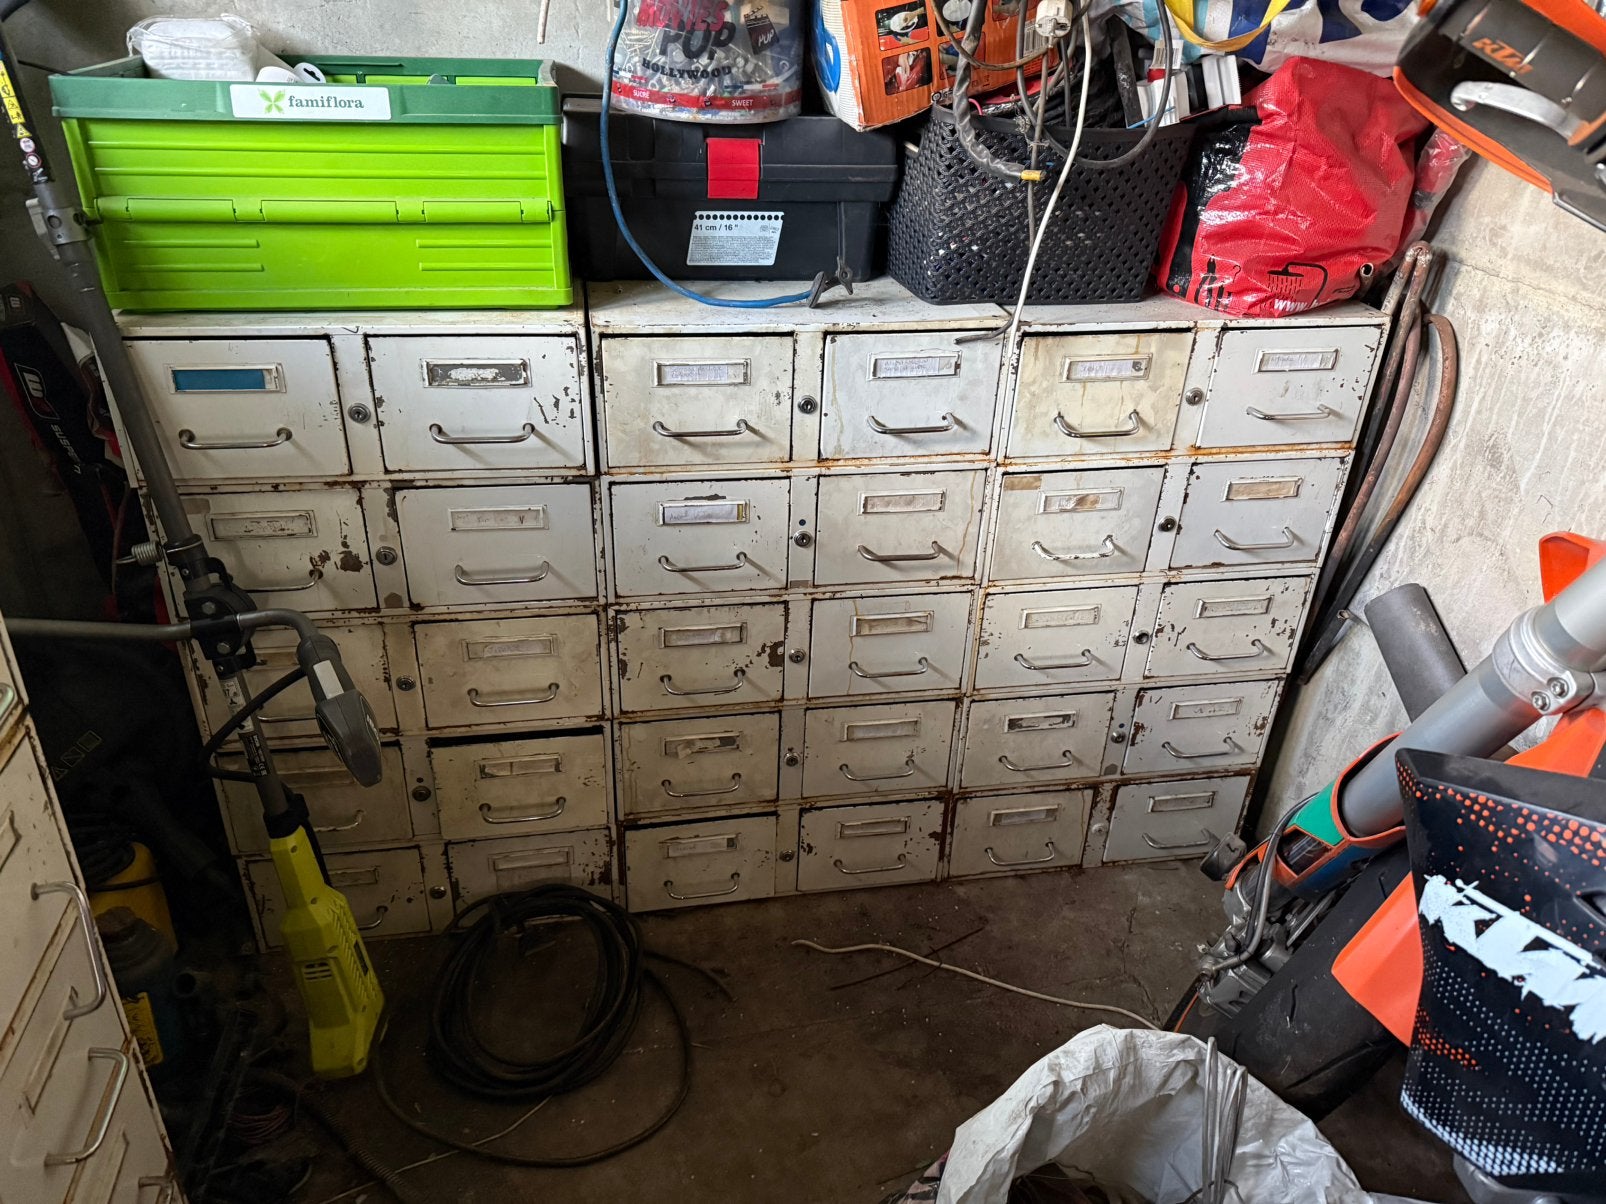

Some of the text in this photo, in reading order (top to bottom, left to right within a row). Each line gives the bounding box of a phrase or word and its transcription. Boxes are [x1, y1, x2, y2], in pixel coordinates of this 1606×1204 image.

[659, 19, 736, 60] POP
[1471, 37, 1534, 75] KTM
[641, 57, 732, 80] HOLLYWOOD
[288, 95, 364, 109] famiflora
[731, 99, 754, 107] SWEET
